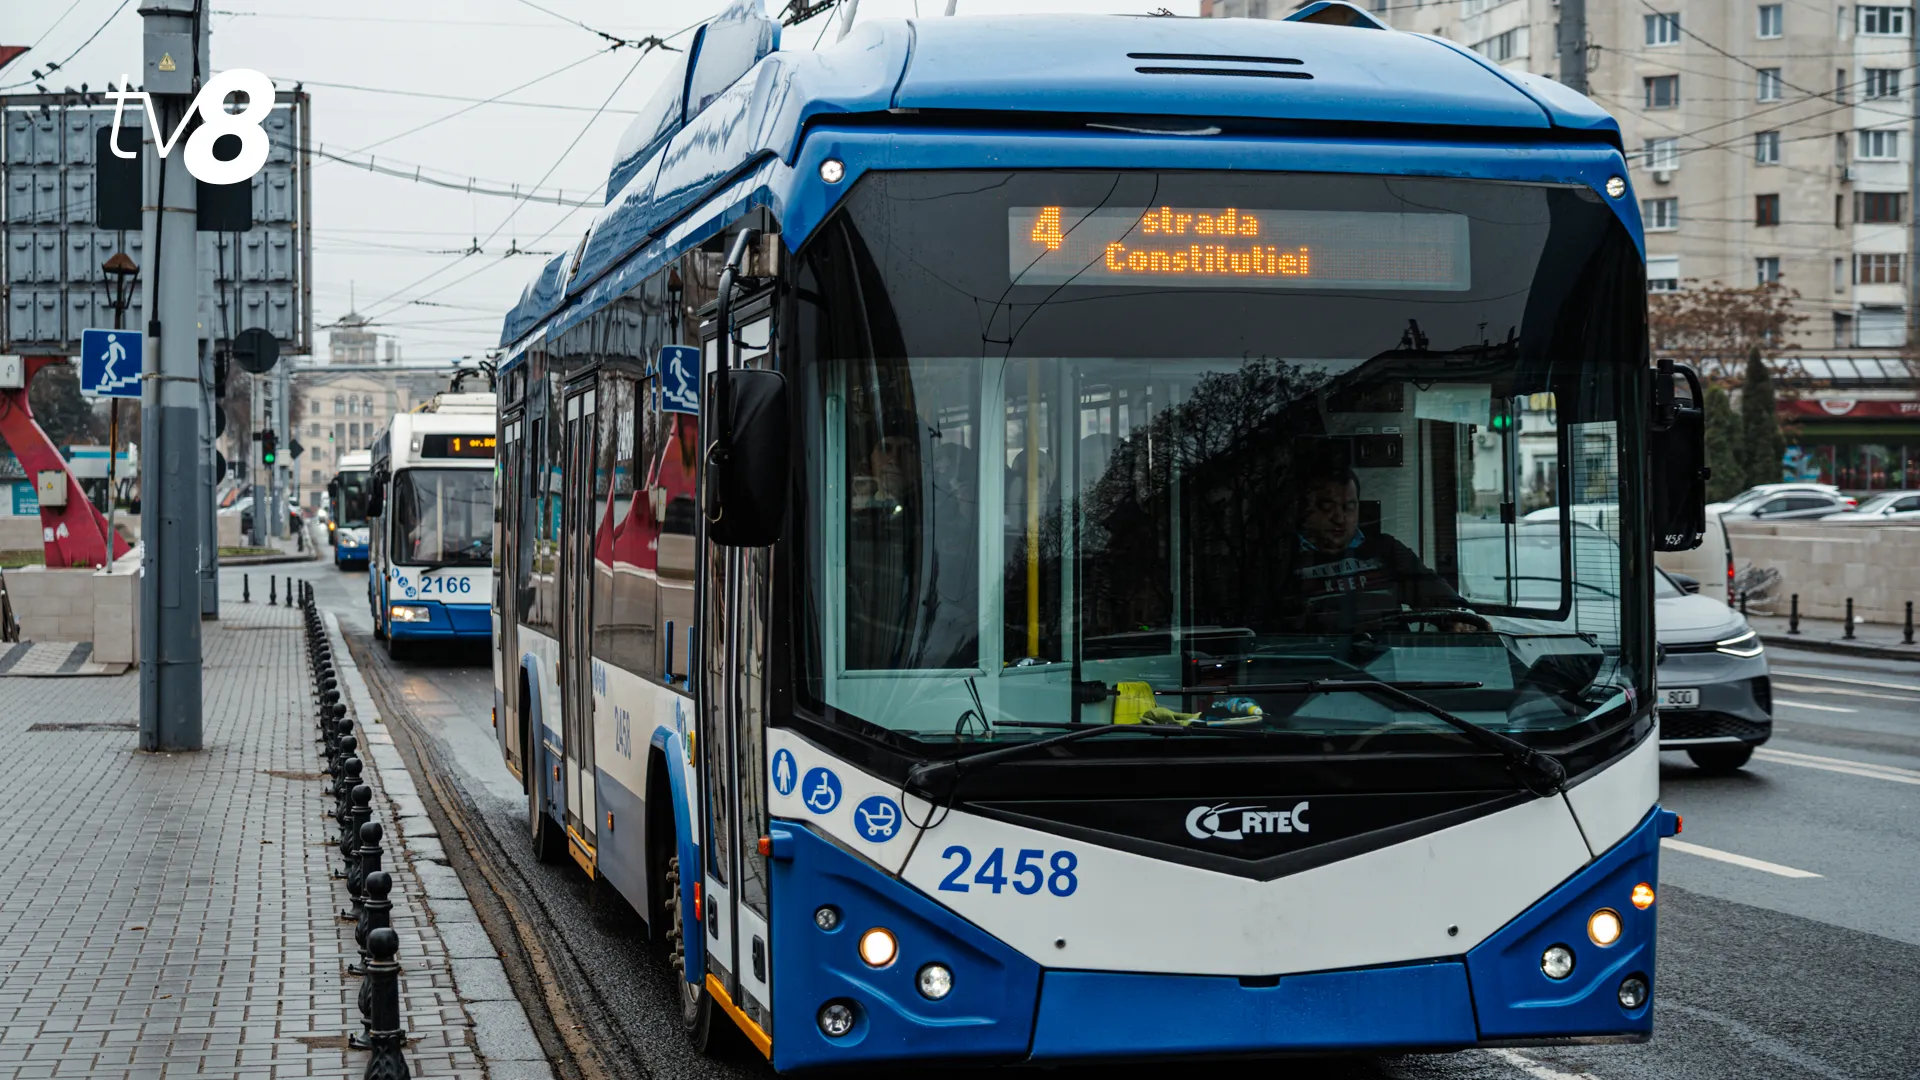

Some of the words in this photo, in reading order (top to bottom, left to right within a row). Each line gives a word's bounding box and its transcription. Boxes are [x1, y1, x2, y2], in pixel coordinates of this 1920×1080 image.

[1031, 206, 1062, 249] 4
[1142, 206, 1258, 235] strada
[1106, 243, 1308, 275] Constitutiei
[453, 437, 461, 451] 1
[421, 576, 471, 594] 2166
[1325, 576, 1367, 593] KEEP
[938, 845, 1079, 897] 2458
